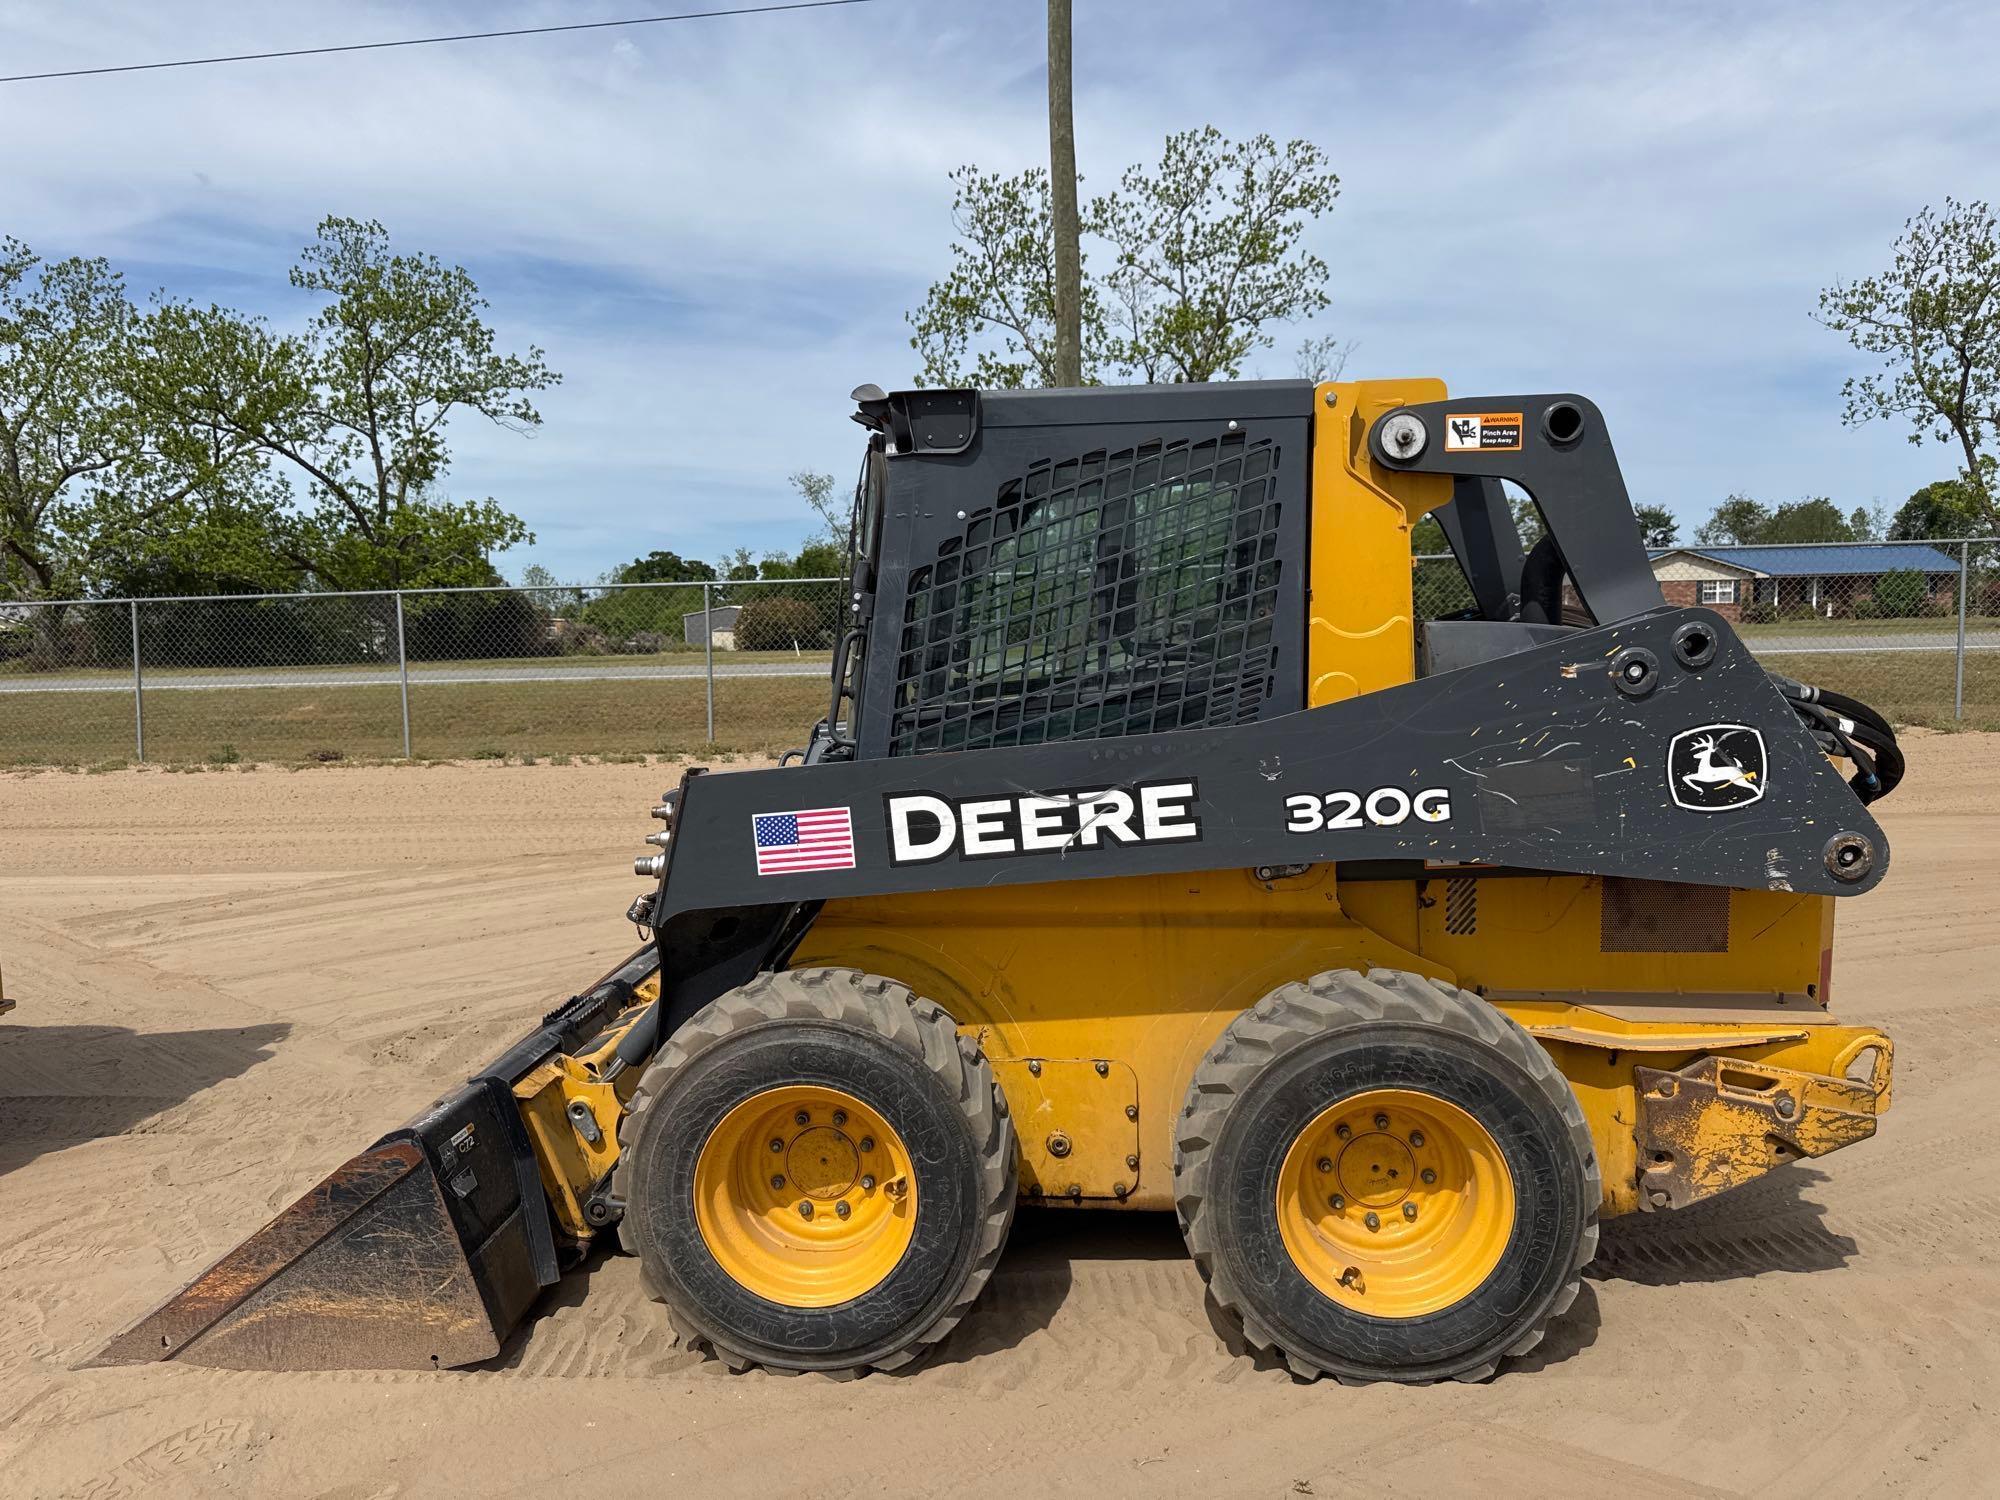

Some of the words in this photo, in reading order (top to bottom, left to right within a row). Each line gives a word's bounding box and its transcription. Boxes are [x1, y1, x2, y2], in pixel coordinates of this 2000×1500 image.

[889, 783, 1197, 861] DEERE
[1286, 787, 1451, 833] 320G
[459, 1135, 475, 1153] C72
